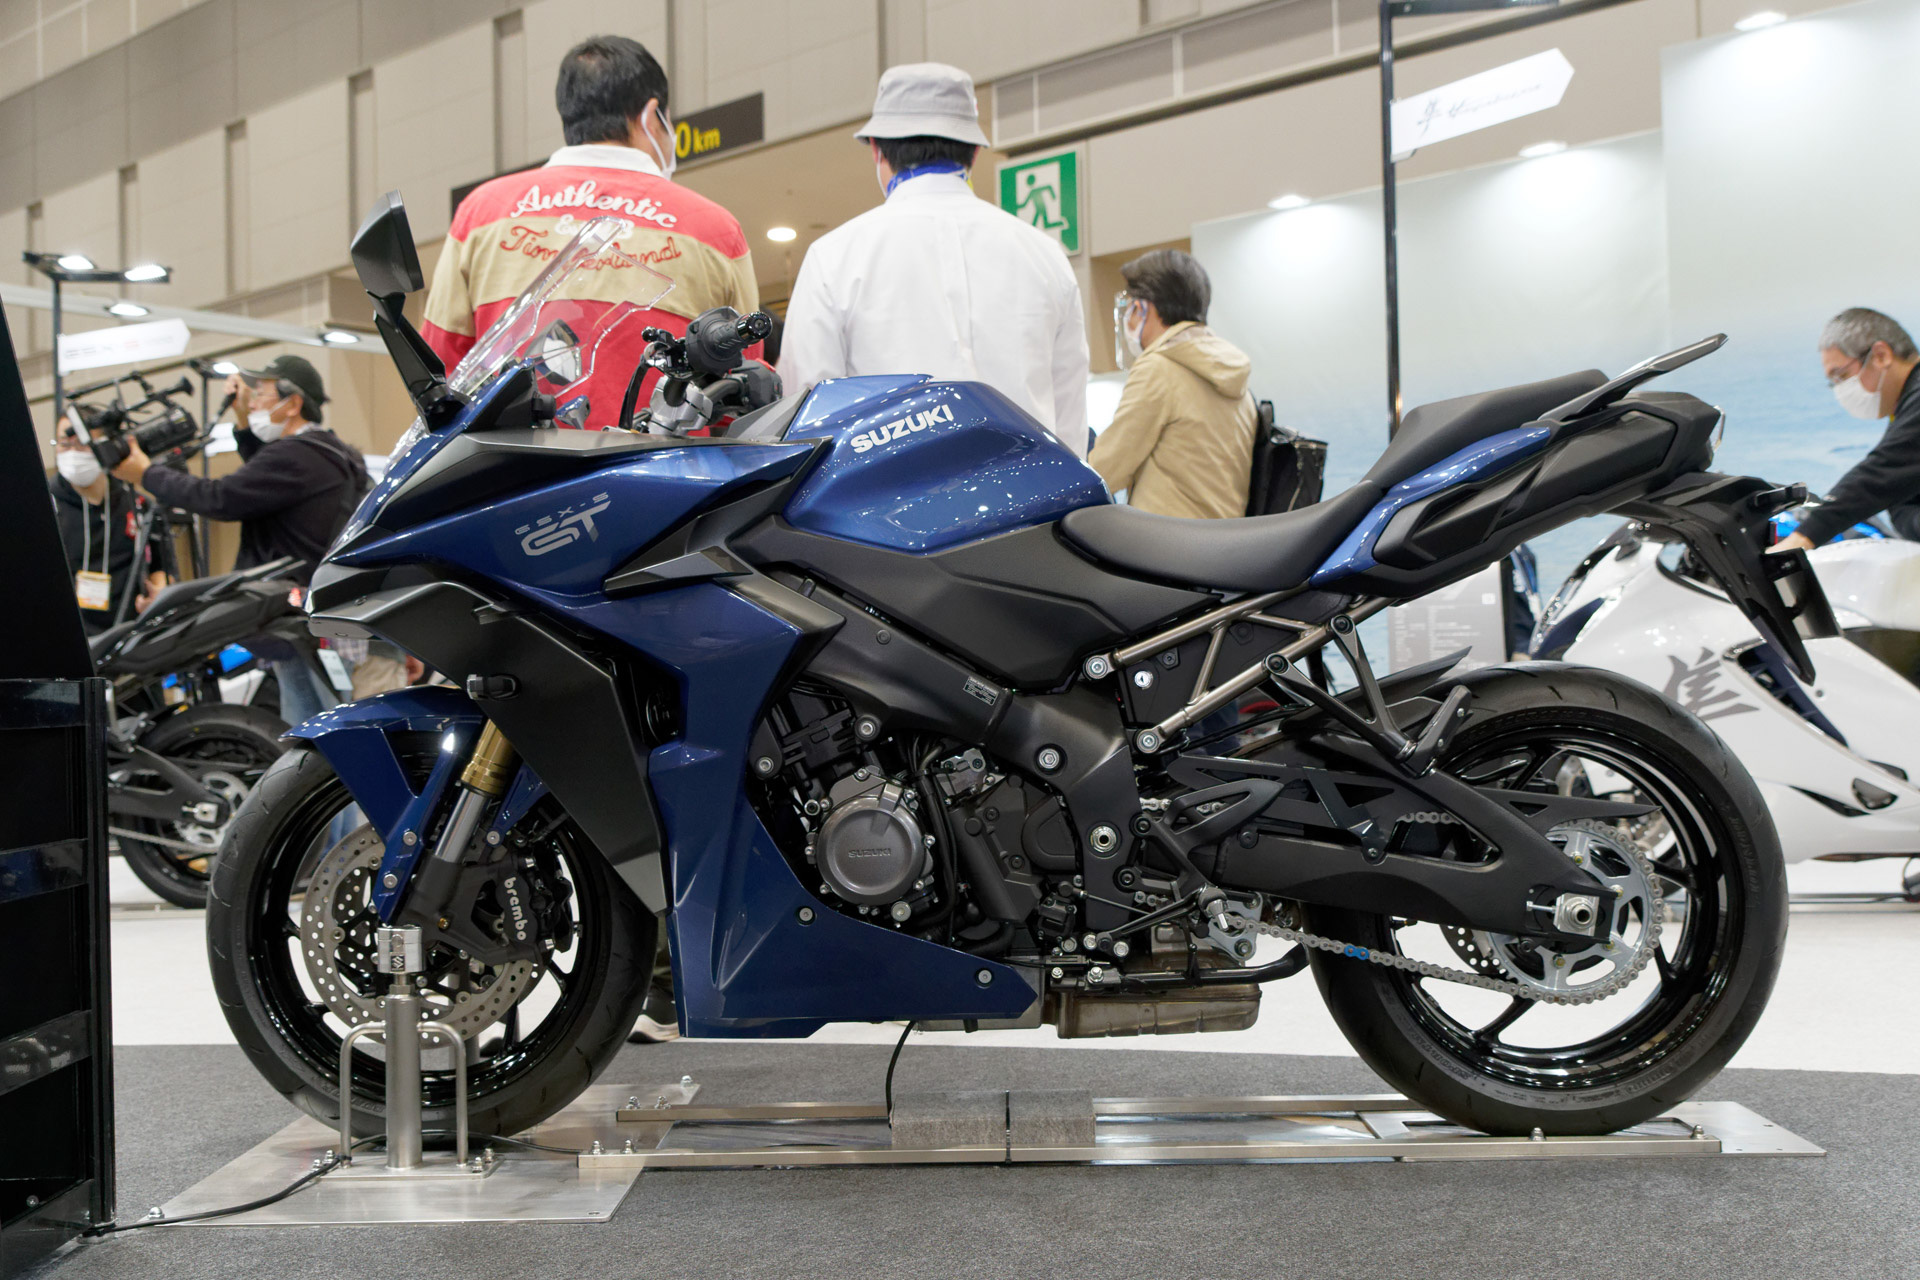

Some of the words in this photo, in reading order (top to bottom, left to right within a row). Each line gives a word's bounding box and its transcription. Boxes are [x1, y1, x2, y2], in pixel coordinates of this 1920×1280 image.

[510, 180, 677, 228] Authentic
[850, 404, 954, 454] SUZUKI
[520, 500, 612, 556] GT
[848, 847, 892, 858] SUZUKI
[504, 876, 528, 941] brembo
